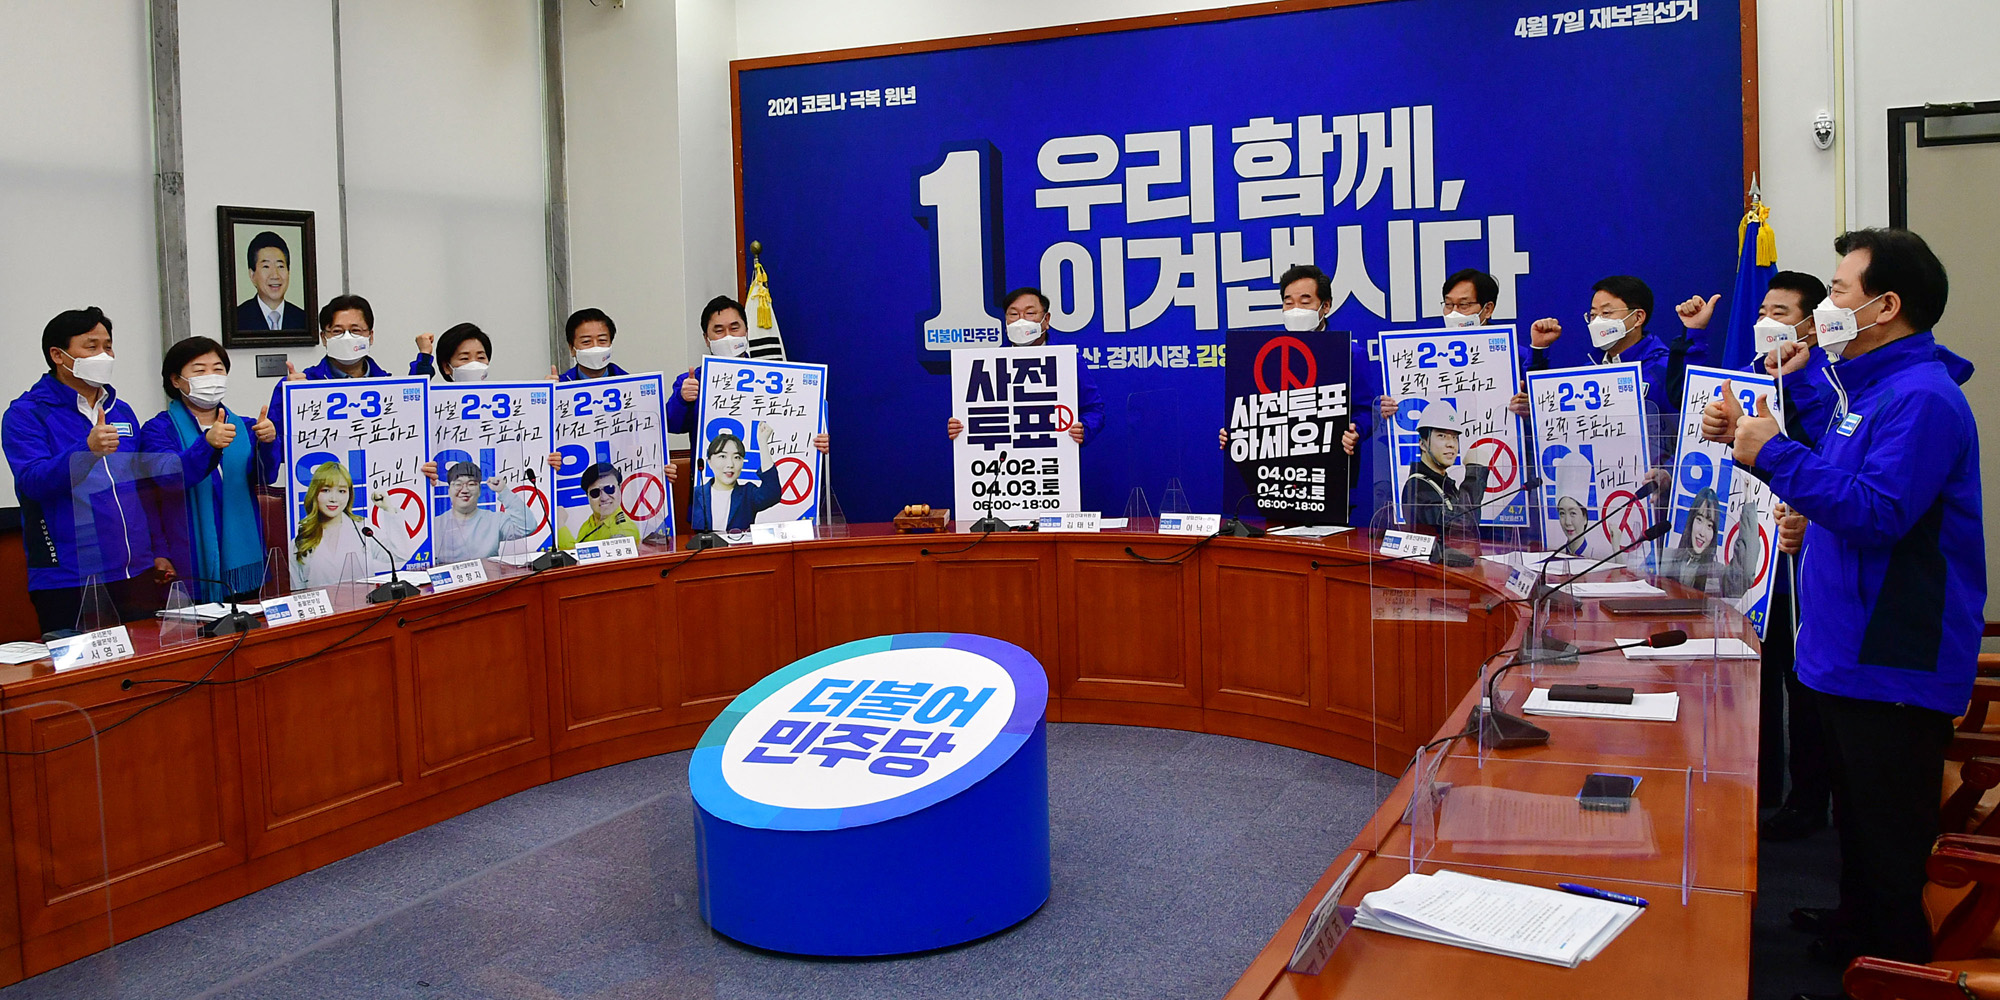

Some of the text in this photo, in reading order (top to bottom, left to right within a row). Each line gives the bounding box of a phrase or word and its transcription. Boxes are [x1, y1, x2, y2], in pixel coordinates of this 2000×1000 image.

[1514, 0, 1699, 39] 4월 7일 재보궐선거
[768, 85, 917, 117] 2021 코로나 극복 원년
[1035, 105, 1465, 231] 우리 함께,
[919, 150, 1003, 351] 1
[1039, 214, 1530, 333] 이겨냅시다
[927, 326, 1000, 344] 더불어민주당
[1392, 349, 1417, 369] 4월
[1417, 341, 1485, 368] 2~3일
[712, 369, 797, 394] 4월 2~3일
[966, 356, 1058, 402] 사전
[1401, 371, 1496, 397] 일찍 투표하고
[297, 391, 397, 421] 4월 2~3일
[435, 393, 526, 420] 4월 2~3일
[556, 388, 637, 418] 월 2~3일
[712, 394, 807, 417] 전날 투표하고
[1230, 383, 1348, 429] 사전투표
[1538, 380, 1615, 412] 4월 2~3일
[298, 418, 419, 449] 먼저 투표하고
[435, 419, 543, 445] 사전 투표하고
[556, 412, 654, 440] 사전 투표하고
[967, 405, 1058, 451] 투표
[1460, 406, 1508, 437] 해요!
[1546, 415, 1626, 443] 일찍 투표하고
[767, 432, 812, 457] 해요!
[1230, 421, 1334, 462] 하세요!
[613, 443, 656, 473] 해요!
[971, 457, 1059, 476] 04.02.금
[1596, 455, 1638, 489] 해요!
[369, 456, 418, 490] 해요!
[971, 478, 1060, 497] 04.03.토
[1257, 465, 1326, 484] 04.02.금
[973, 499, 1060, 511] 06:00~18:00
[1257, 482, 1326, 501] 04.03.토
[1257, 499, 1325, 512] 06:00~18:00
[415, 552, 430, 561] 4.7
[1750, 610, 1764, 623] 4.7
[91, 643, 126, 660] 서영교
[788, 677, 998, 728] 더불어
[742, 719, 957, 778] 민주당
